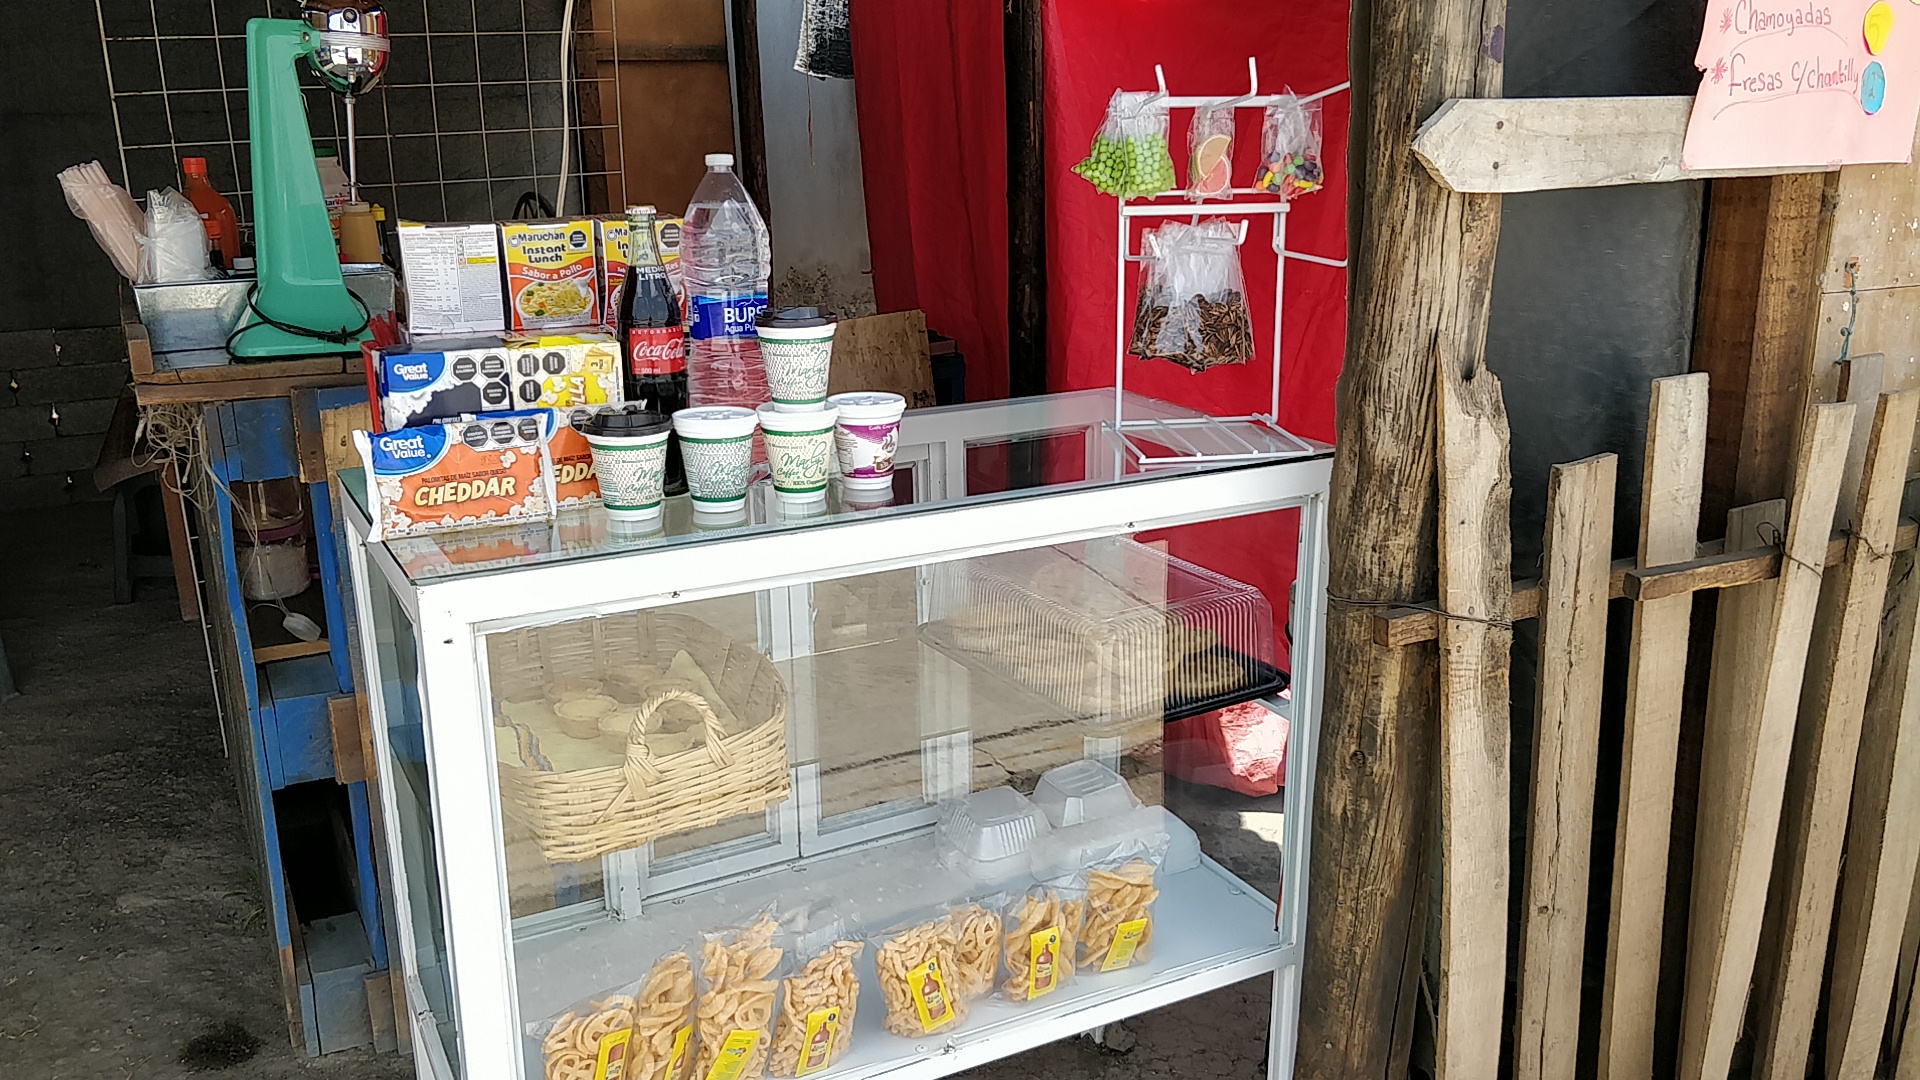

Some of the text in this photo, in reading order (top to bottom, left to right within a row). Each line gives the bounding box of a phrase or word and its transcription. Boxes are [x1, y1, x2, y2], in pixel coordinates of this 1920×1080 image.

[1735, 0, 1831, 36] Chamoyadas
[518, 232, 566, 242] Maruchan
[522, 244, 567, 254] Instant
[528, 254, 563, 263] Lunch
[522, 267, 550, 279] Sabor
[560, 265, 582, 277] Pollo
[724, 324, 743, 334] Agua
[393, 363, 428, 375] Great
[402, 372, 429, 381] Value
[380, 435, 425, 452] Great
[392, 448, 426, 459] Value
[554, 462, 598, 485] EDDA
[414, 476, 516, 507] CHEDDAR
